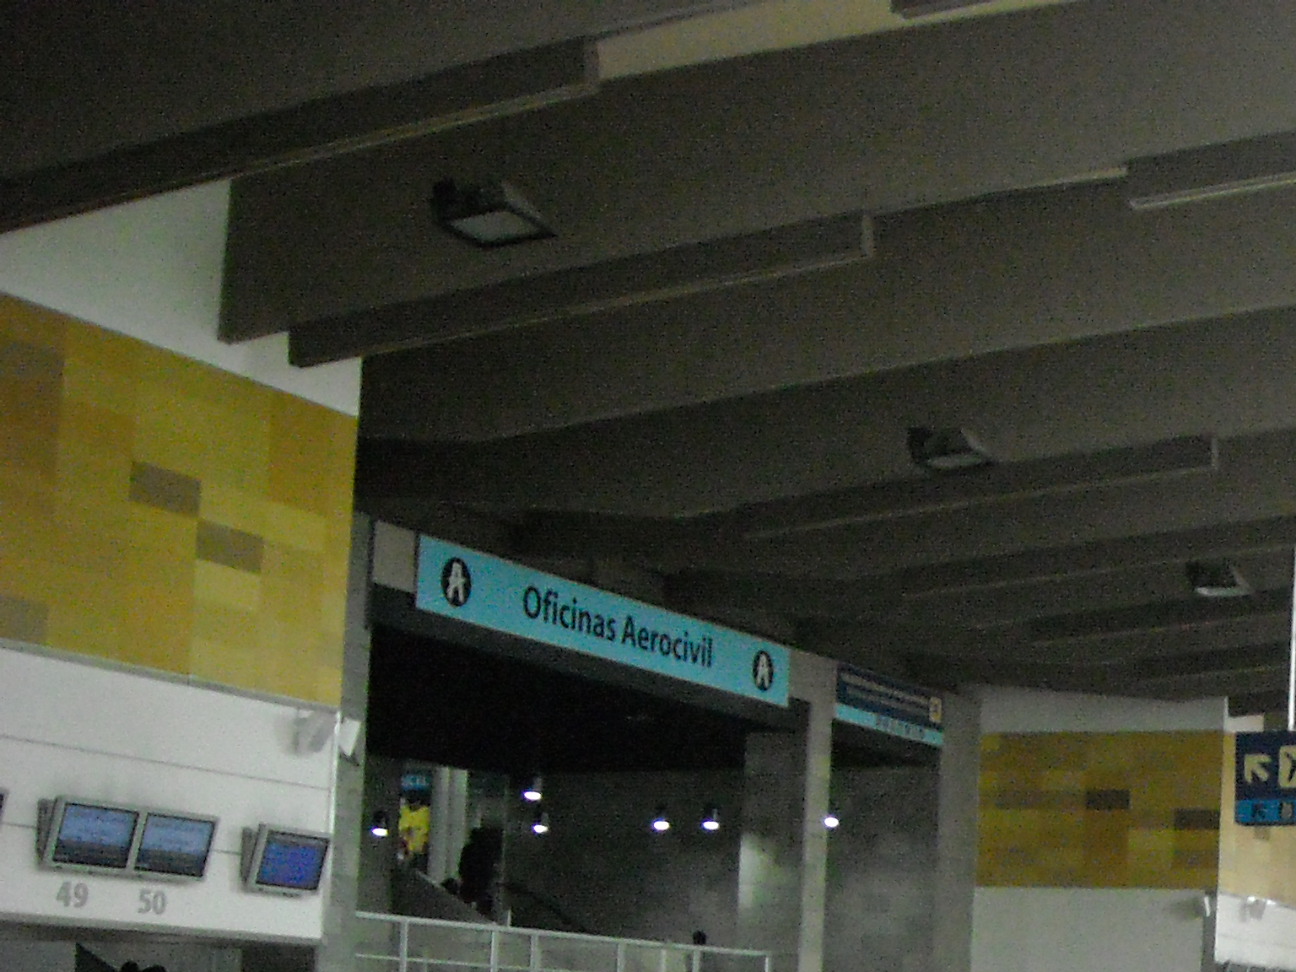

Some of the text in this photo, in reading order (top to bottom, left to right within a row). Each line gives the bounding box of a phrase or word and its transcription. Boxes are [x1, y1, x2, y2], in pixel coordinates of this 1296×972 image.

[523, 585, 714, 668] Oficinas Aerocivil
[55, 881, 90, 909] 49
[137, 889, 167, 915] 50
